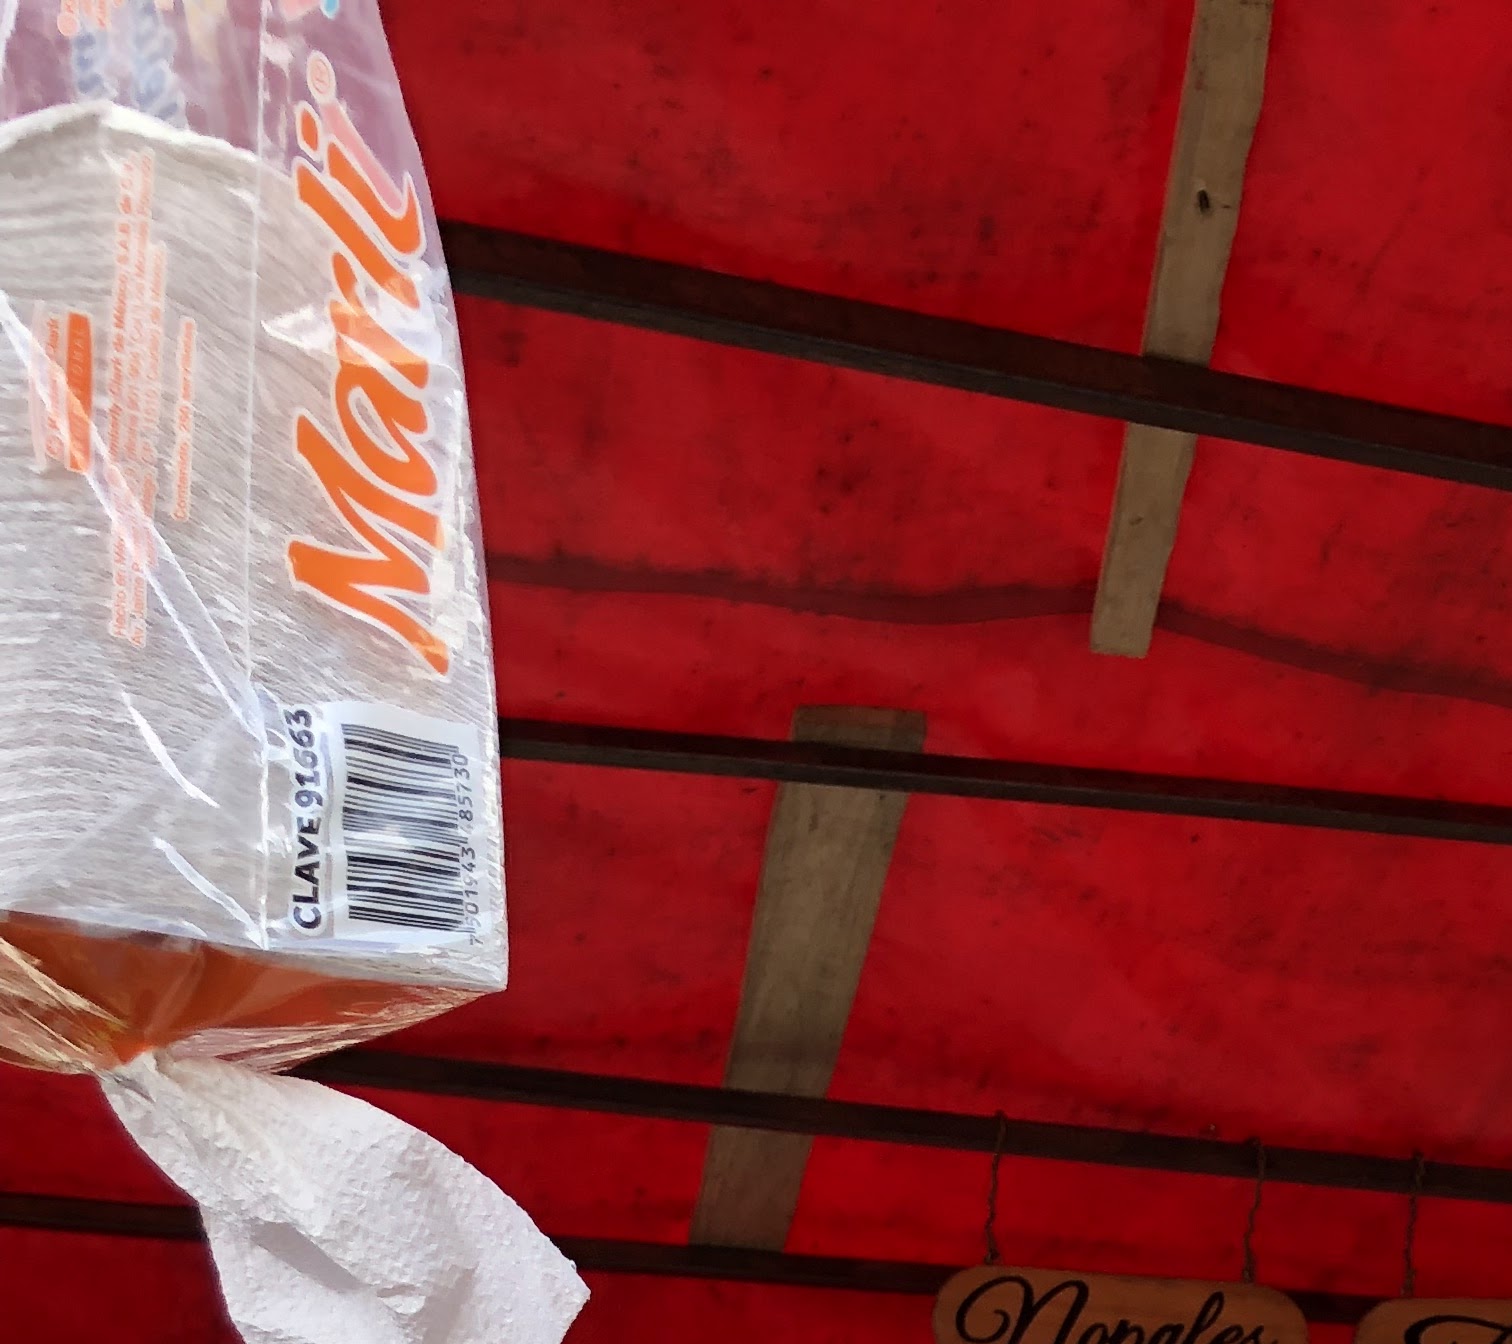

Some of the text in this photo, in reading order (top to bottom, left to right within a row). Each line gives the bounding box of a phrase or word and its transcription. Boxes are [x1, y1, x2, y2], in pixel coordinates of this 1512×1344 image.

[286, 97, 450, 677] Marli
[283, 708, 323, 930] CLAVE 91663
